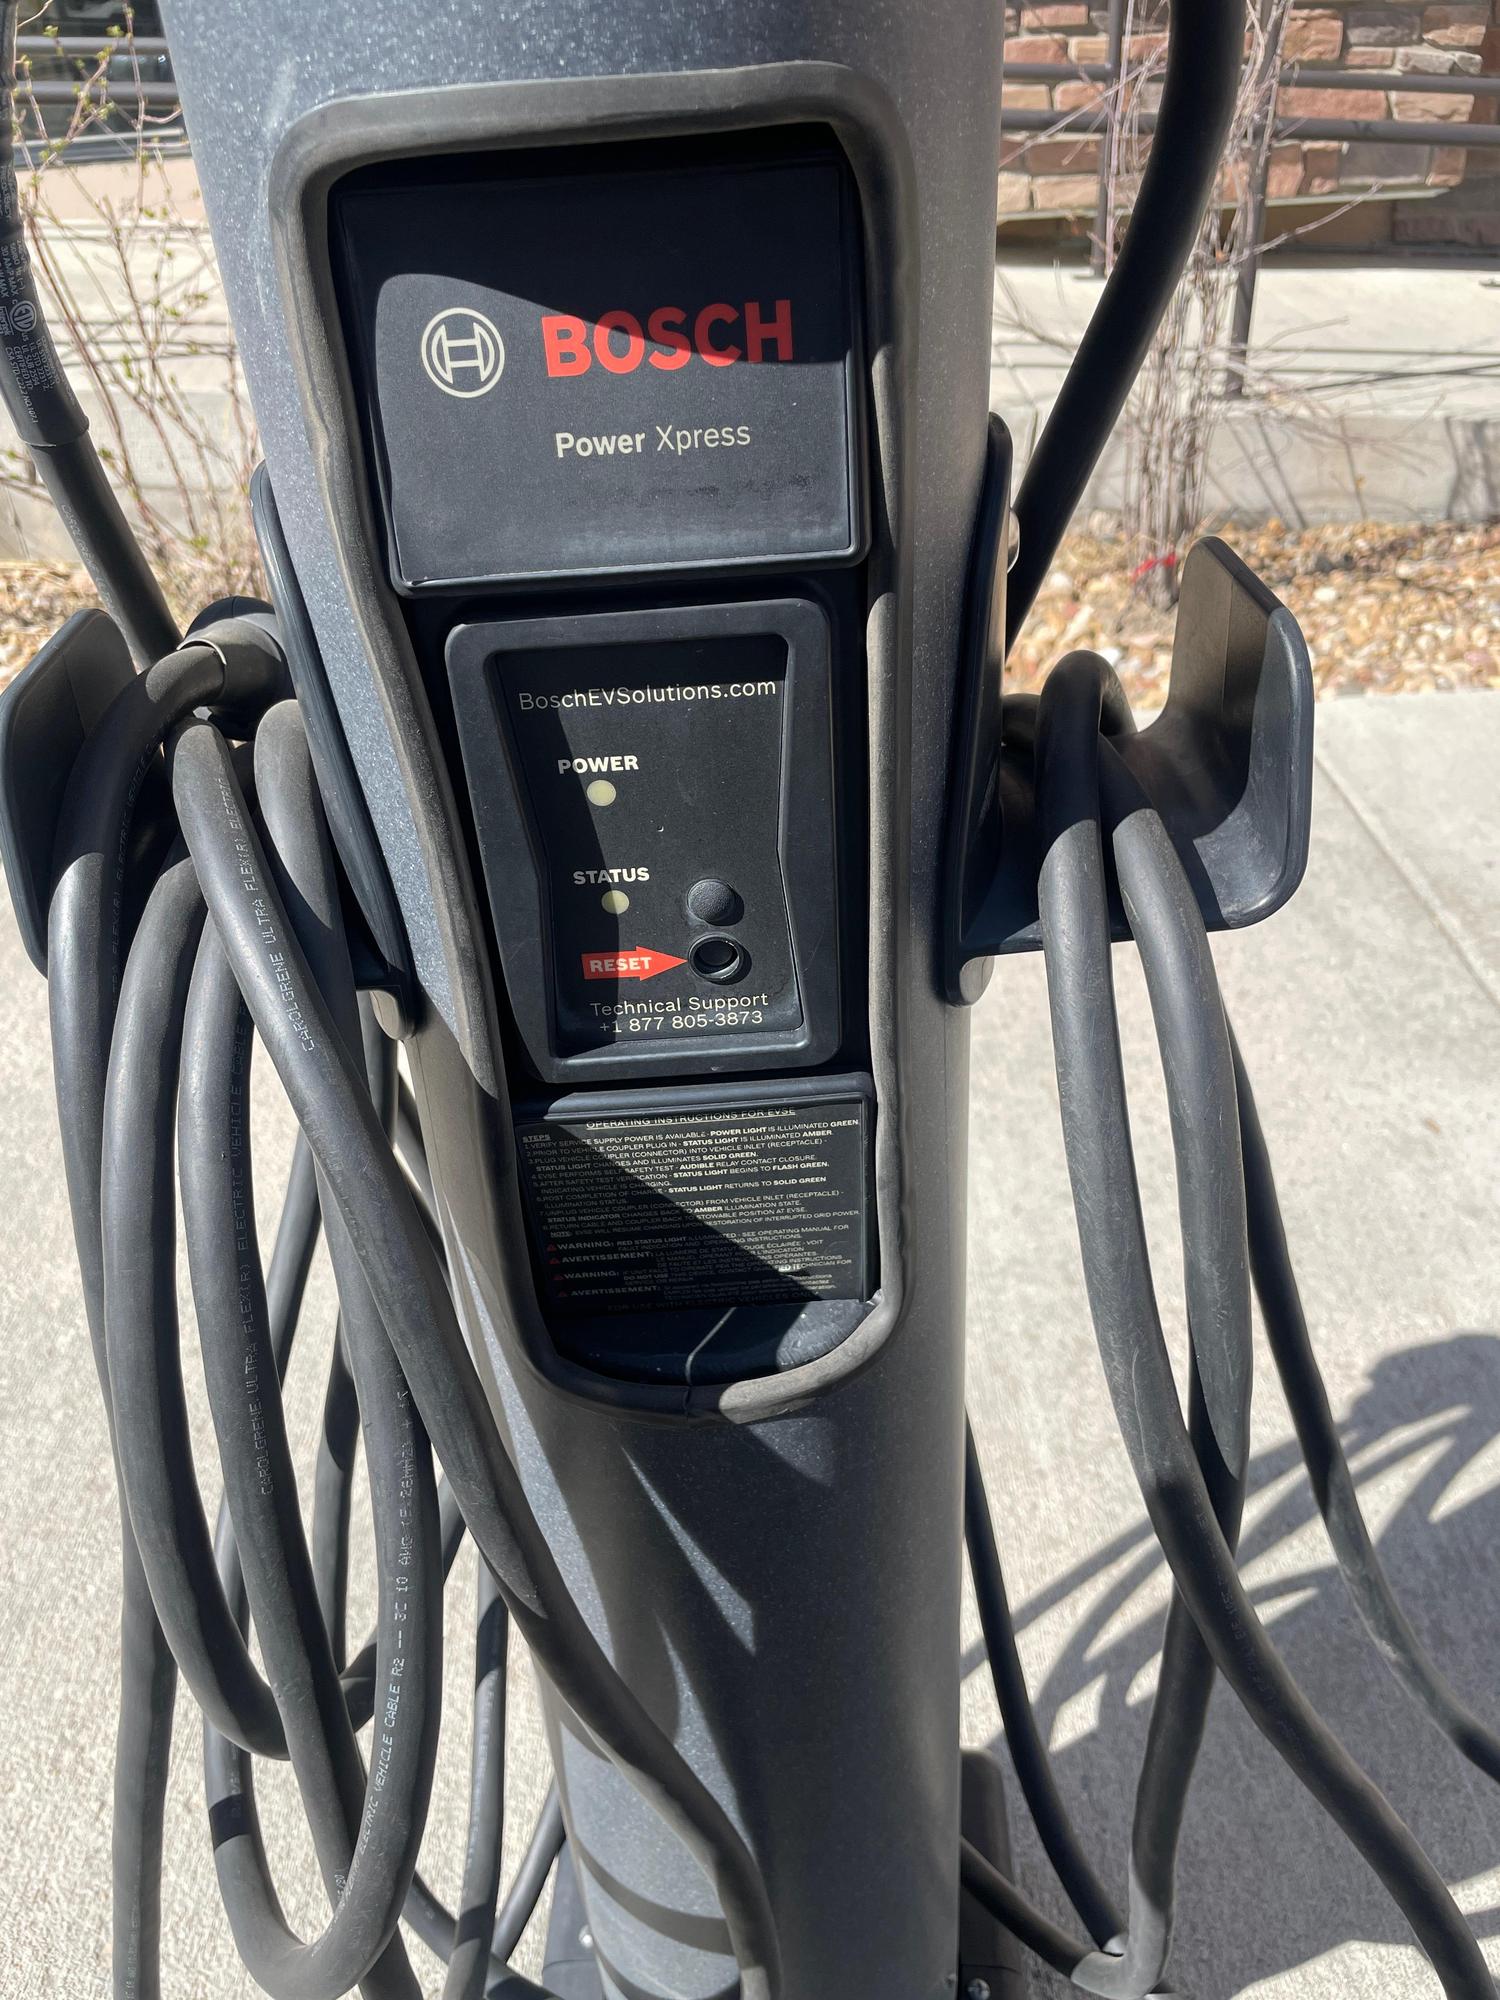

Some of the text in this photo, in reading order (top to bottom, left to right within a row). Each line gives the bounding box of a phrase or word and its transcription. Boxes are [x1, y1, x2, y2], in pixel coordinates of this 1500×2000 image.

[541, 298, 794, 378] BOSCH
[6, 347, 14, 362] CSA
[30, 368, 40, 386] 2594
[555, 424, 750, 458] Power Xpress
[519, 680, 776, 710] BoschEVSolutions.com
[558, 754, 639, 774] POWER
[573, 867, 650, 884] STATUS
[252, 899, 276, 944] ULTRA
[590, 957, 652, 973] RESET
[590, 992, 768, 1016] Technical Support
[600, 1010, 763, 1033] +1 877 805-3873
[594, 1136, 622, 1144] SUPPLY
[624, 1134, 654, 1142] POWER
[666, 1130, 706, 1139] AVAILABLE
[710, 1127, 741, 1136] POWER
[742, 1126, 766, 1134] LIGHT
[778, 1121, 828, 1131] ILLUMINATED
[830, 1118, 858, 1127] GREEN
[606, 1142, 644, 1152] COUPLER
[646, 1140, 668, 1148] PLUG
[683, 1138, 712, 1146] STATUS
[714, 1136, 738, 1144] LIGHT
[750, 1132, 800, 1142] ILLUMINATED
[632, 1147, 687, 1157] (CONNECTOR)
[689, 1146, 707, 1154] INTO
[710, 1144, 741, 1152] VEHICLE
[744, 1142, 764, 1150] INLET
[768, 1138, 822, 1148] (RECEPTACLE)
[568, 1162, 591, 1170] LIGHT
[651, 1154, 701, 1164] ILLUMINATES
[702, 1153, 726, 1161] SOLID
[674, 1170, 702, 1178] STATUS
[704, 1168, 727, 1176] LIGHT
[730, 1166, 758, 1174] BEGINS
[772, 1163, 798, 1172] FLASH
[800, 1161, 830, 1170] GREEN.
[680, 1160, 714, 1170] AUDIBLE
[716, 1159, 739, 1167] RELAY
[741, 1156, 776, 1166] CONTACT
[668, 1184, 697, 1193] STATUS
[700, 1183, 722, 1191] LIGHT
[724, 1180, 759, 1190] RETURNS
[774, 1178, 797, 1186] SOLID
[799, 1176, 826, 1184] GREEN
[694, 1204, 722, 1213] AMBER
[725, 1201, 776, 1211] ILLUMINATION
[706, 1197, 728, 1205] FROM
[731, 1194, 760, 1203] VEHICLE
[763, 1193, 784, 1201] INLET
[696, 1211, 737, 1220] STOWABLE
[739, 1208, 774, 1217] POSITION
[764, 1212, 812, 1222] INTERRUPTED
[758, 1227, 799, 1236] OPERATING
[801, 1225, 832, 1234] MANUAL
[391, 1657, 404, 1676] R2
[384, 1683, 400, 1728] CABLE
[374, 1733, 394, 1793] VEHICLE
